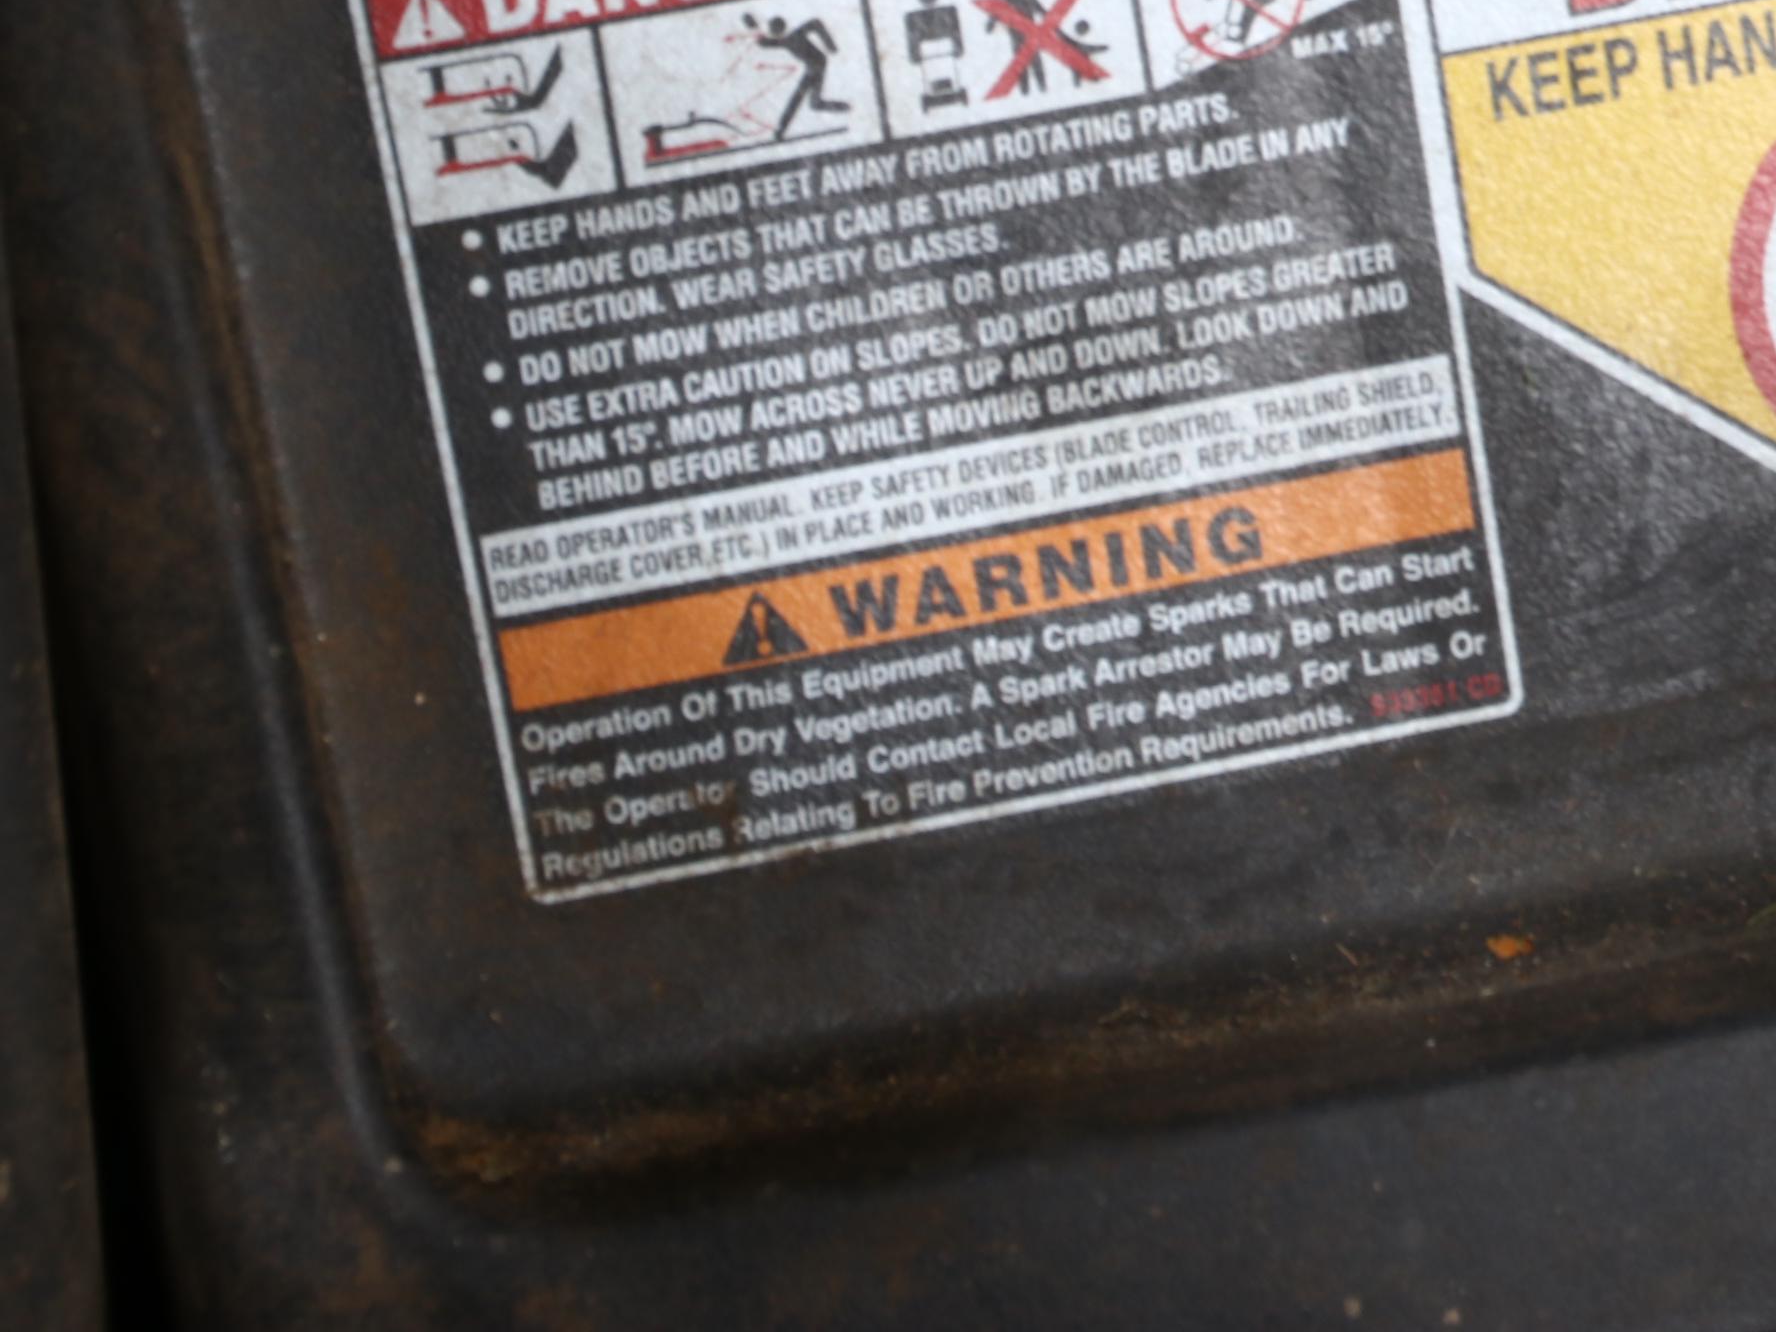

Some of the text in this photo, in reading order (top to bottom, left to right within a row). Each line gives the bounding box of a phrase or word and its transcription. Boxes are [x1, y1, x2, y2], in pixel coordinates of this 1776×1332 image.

[1485, 36, 1643, 123] KEEP
[495, 91, 1238, 255] KEEP HANDS AND FEET AWAY FROM ROTATING PARTS.
[503, 116, 1352, 302] REMOVE OBJECTS THAT CAN BE THROWN BY THE BLADE IN ANY
[506, 220, 1009, 340] DIRECTION. WEAR SAFETY GLASSES.
[518, 237, 1172, 386] DO NOT MOW WHEN CHILDREN OR OTHERS ARE
[523, 241, 1397, 433] USE EXTRA CAUTION ON SLOPES. DO NOT MOW SLOPES GREATER
[528, 279, 1410, 472] THAN MOW ACROSS NEVER UP AND LOOK DOWN AND
[536, 388, 1041, 511] BEHIND BEFORE AND WHILE MOVING
[488, 443, 1048, 572] READ OPERATOR'S KEEP SAFETY DEVICES
[494, 501, 925, 606] DISCHARGE PLACE AND
[826, 503, 1265, 641] WARNING
[518, 543, 1475, 758] Operation Of This Equipment May Create Sparks That Can Start
[610, 586, 1480, 780] Around Dry Vegetation. Spark Arrestor May Be Required.
[748, 628, 1489, 798] Should Contact Local Fire Agencies For Laws Or
[862, 699, 1354, 820] To Fire Prevention Requirements.
